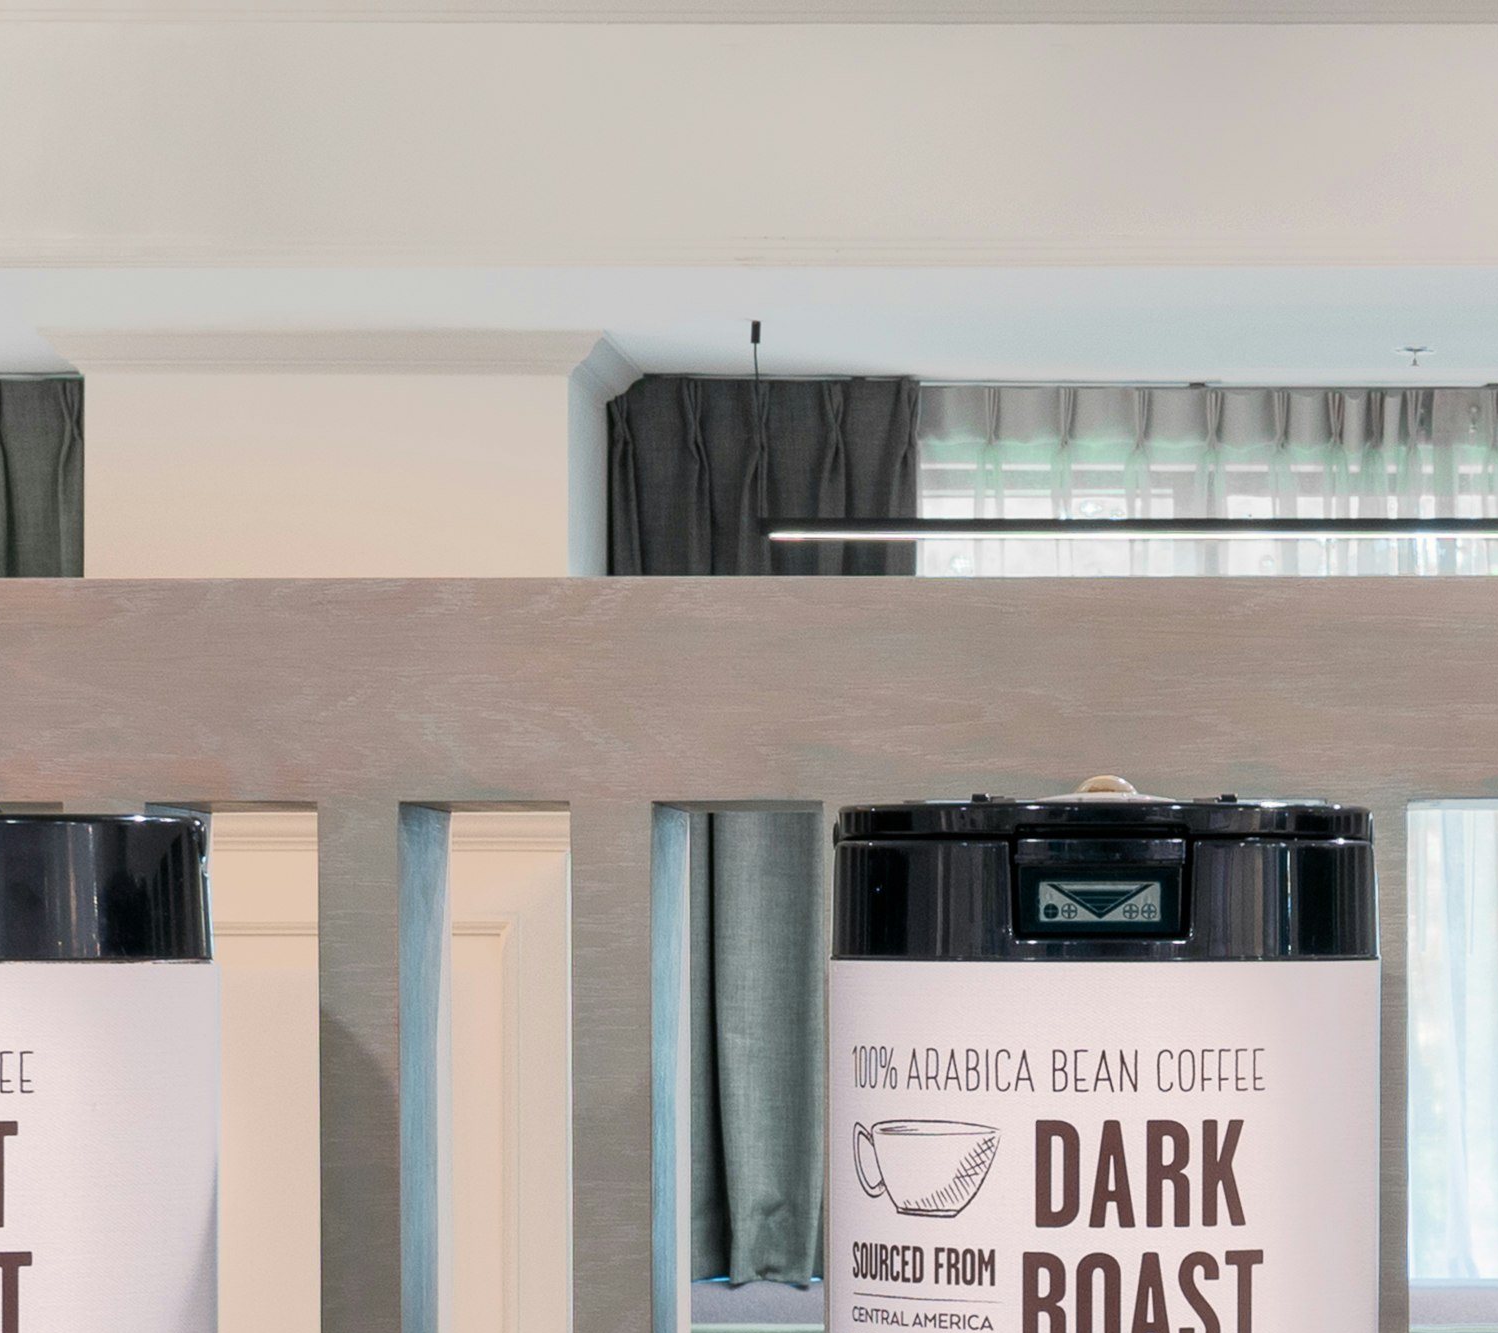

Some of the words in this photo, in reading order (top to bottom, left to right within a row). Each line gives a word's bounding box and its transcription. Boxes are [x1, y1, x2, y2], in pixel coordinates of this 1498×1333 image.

[852, 1045, 898, 1090] 100%
[906, 1047, 1035, 1093] ARABICA
[1052, 1048, 1139, 1093] BEAN
[1157, 1048, 1266, 1092] COFFEE
[1035, 1119, 1246, 1229] DARK
[853, 1241, 924, 1283] SOURCED
[934, 1246, 996, 1287] FROM
[852, 1305, 909, 1327] CENTRAL
[912, 1312, 994, 1331] AMERICA
